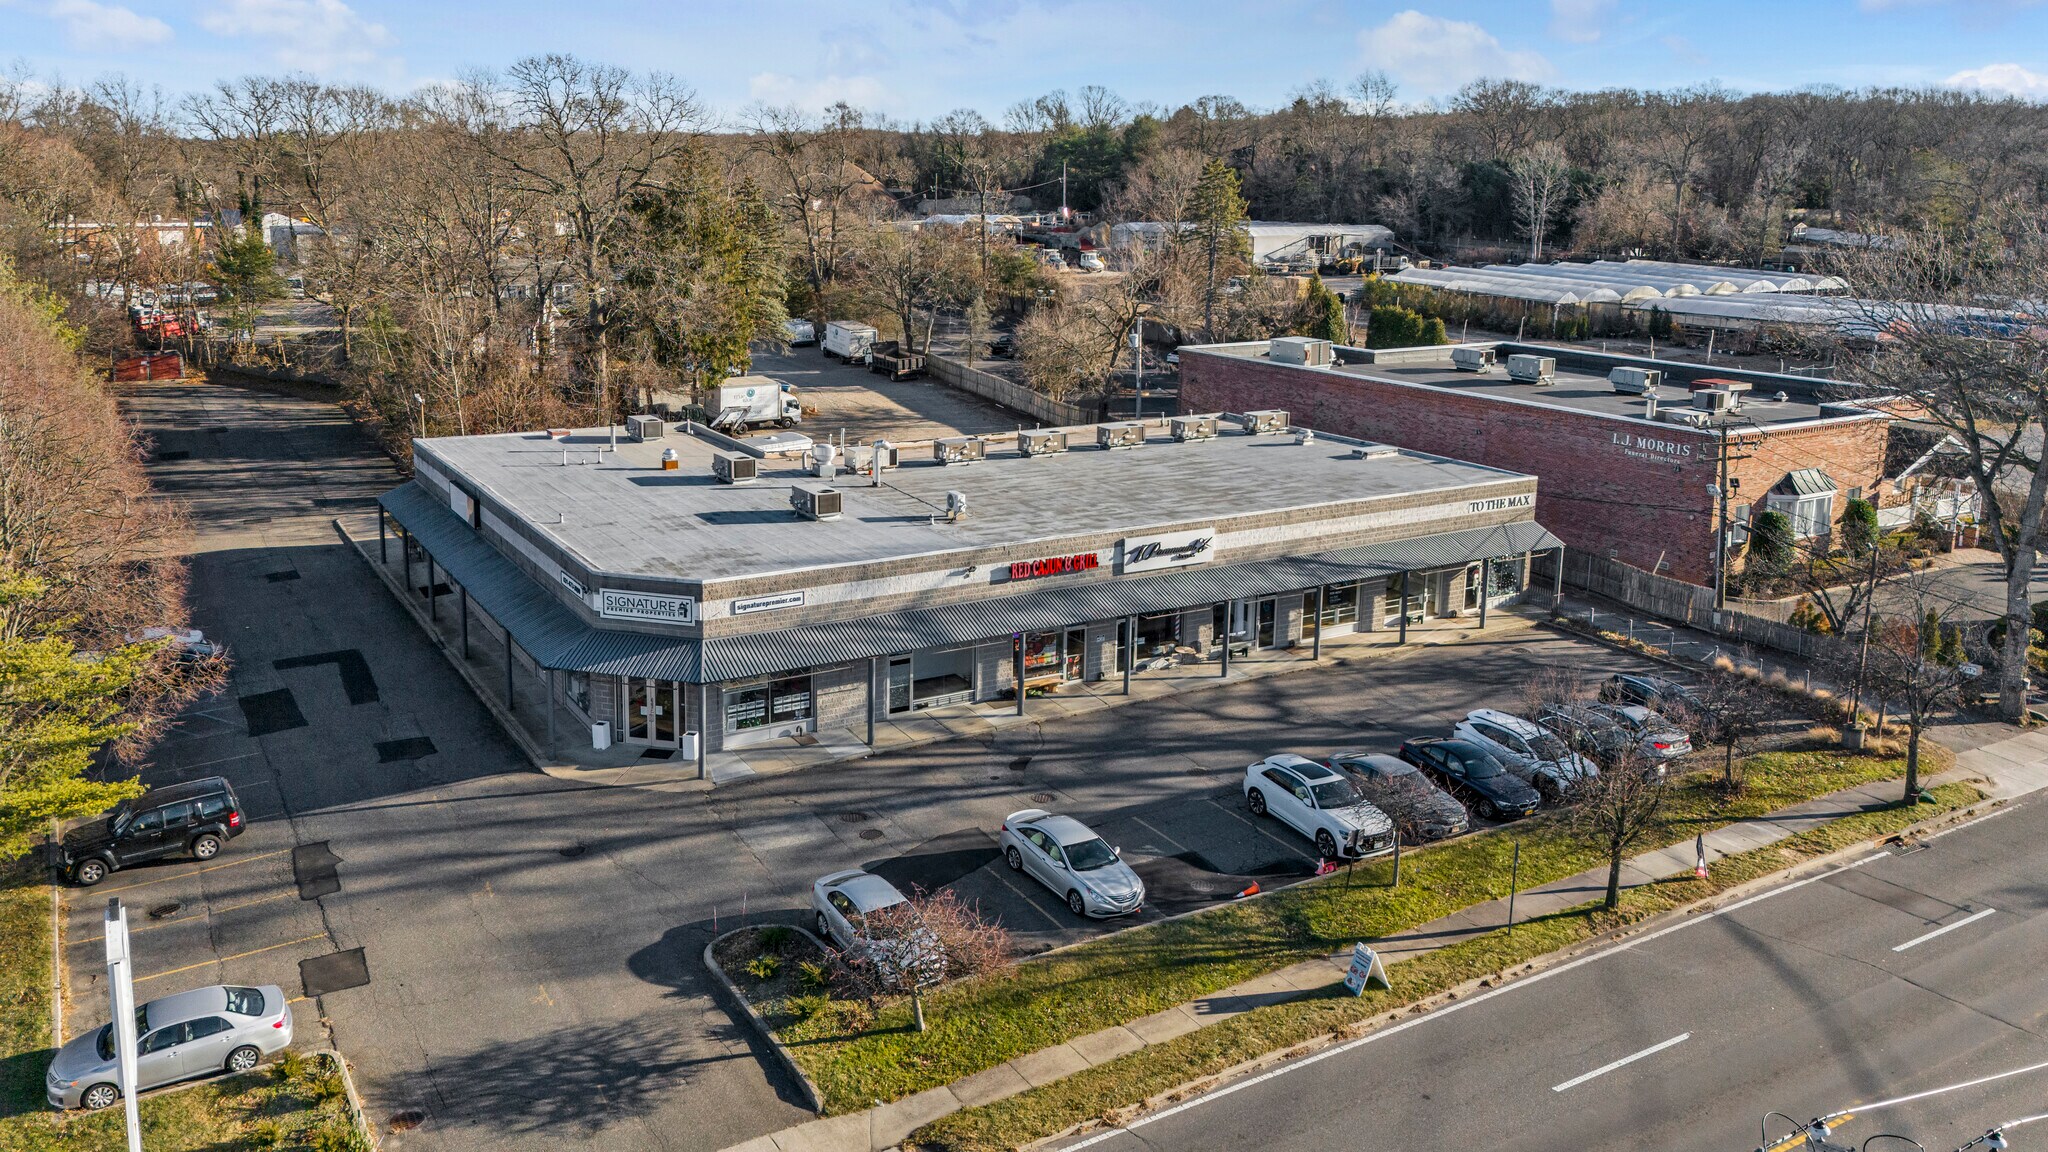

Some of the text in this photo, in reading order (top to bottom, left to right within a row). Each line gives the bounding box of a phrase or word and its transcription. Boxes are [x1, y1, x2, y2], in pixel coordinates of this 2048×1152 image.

[1612, 432, 1691, 456] I.J. MORRIS
[1624, 448, 1681, 464] Funeral Directors
[1470, 495, 1531, 512] TO THE MAX
[1011, 552, 1099, 579] RED CAJUN & GRILL
[606, 595, 676, 612] SIGNATURE
[737, 596, 802, 611] signaturepremier.com
[636, 608, 676, 618] PROPERTIES
